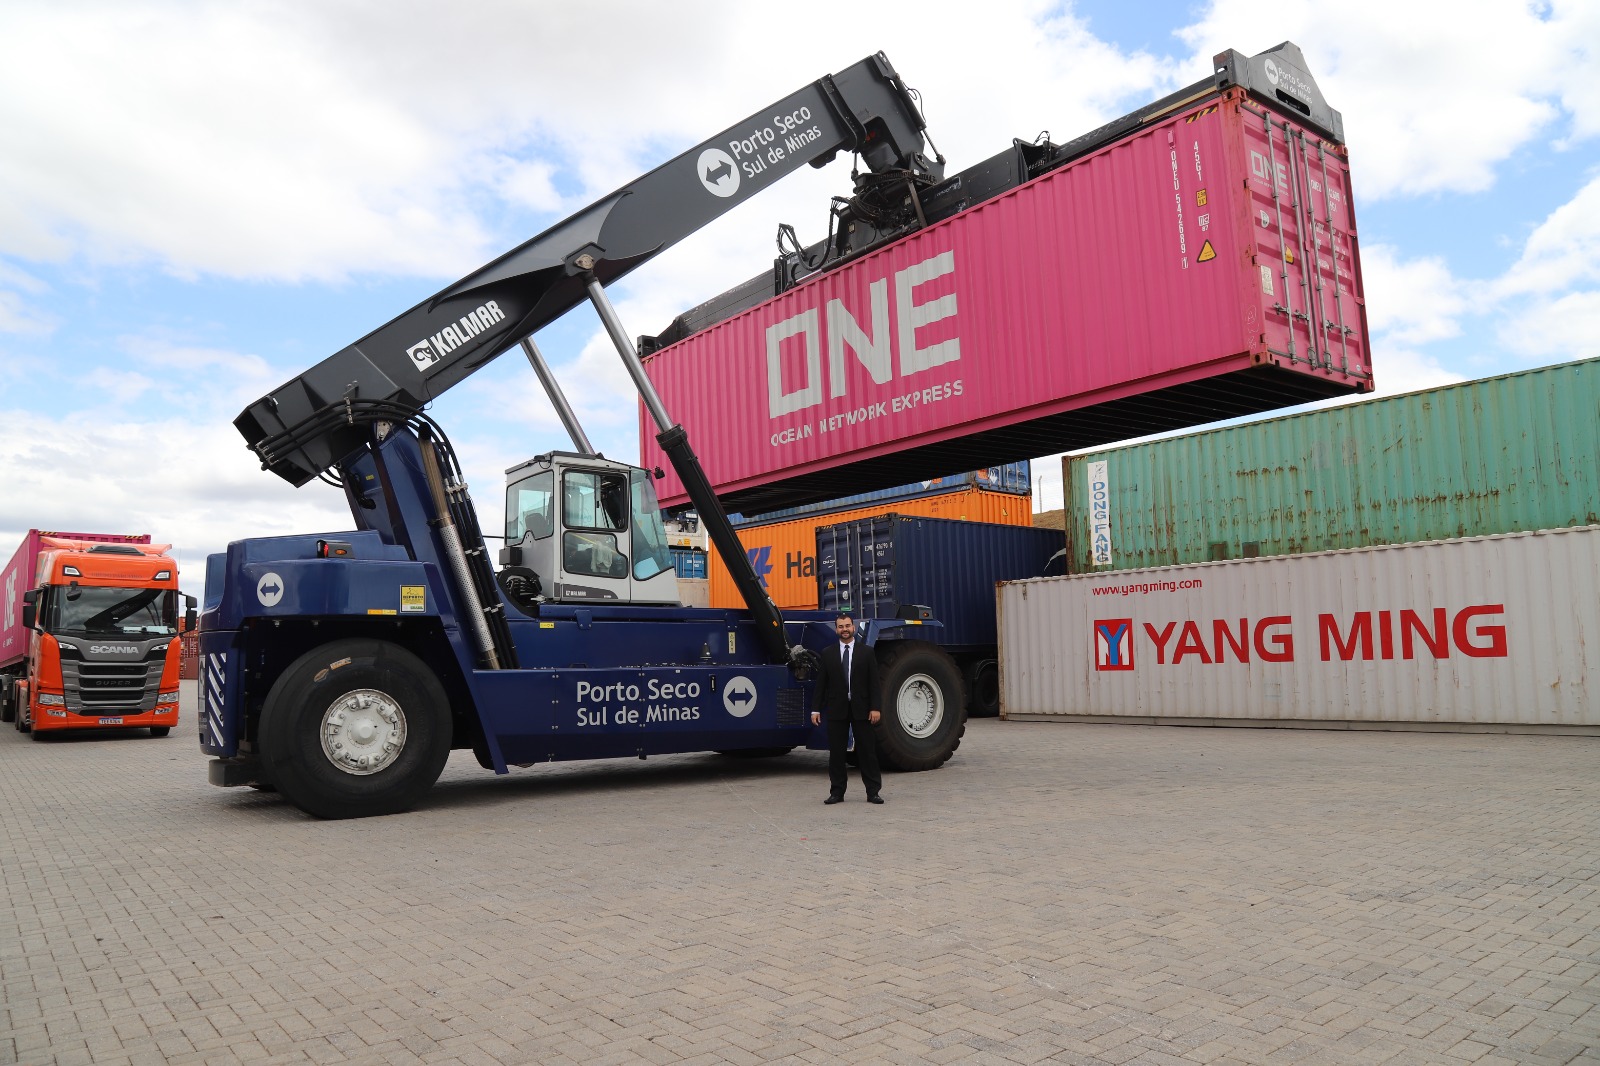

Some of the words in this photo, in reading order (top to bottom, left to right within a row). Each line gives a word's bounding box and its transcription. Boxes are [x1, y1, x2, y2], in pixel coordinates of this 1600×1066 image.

[729, 127, 775, 160] Porto
[774, 107, 811, 135] Seco
[742, 155, 767, 178] Sul
[767, 146, 785, 164] de
[785, 125, 822, 154] Minas
[1170, 151, 1180, 190] ONEU
[1251, 150, 1288, 189] ONE
[430, 300, 506, 357] KALMAR
[766, 250, 961, 419] ONE
[770, 423, 813, 447] OCEAN
[820, 401, 887, 434] NETWORK
[892, 379, 963, 413] EXPRESS
[1092, 481, 1107, 520] DONG
[1094, 523, 1109, 563] FANG
[786, 551, 817, 582] Ha
[1092, 579, 1203, 596] www.yangming.com
[89, 645, 139, 654] SCANIA
[1143, 615, 1295, 665] YANG
[1318, 604, 1508, 662] MING
[576, 681, 640, 703] Porto
[648, 679, 701, 701] Seco
[576, 707, 608, 727] Sul
[614, 706, 640, 725] de
[646, 704, 701, 724] Minas
